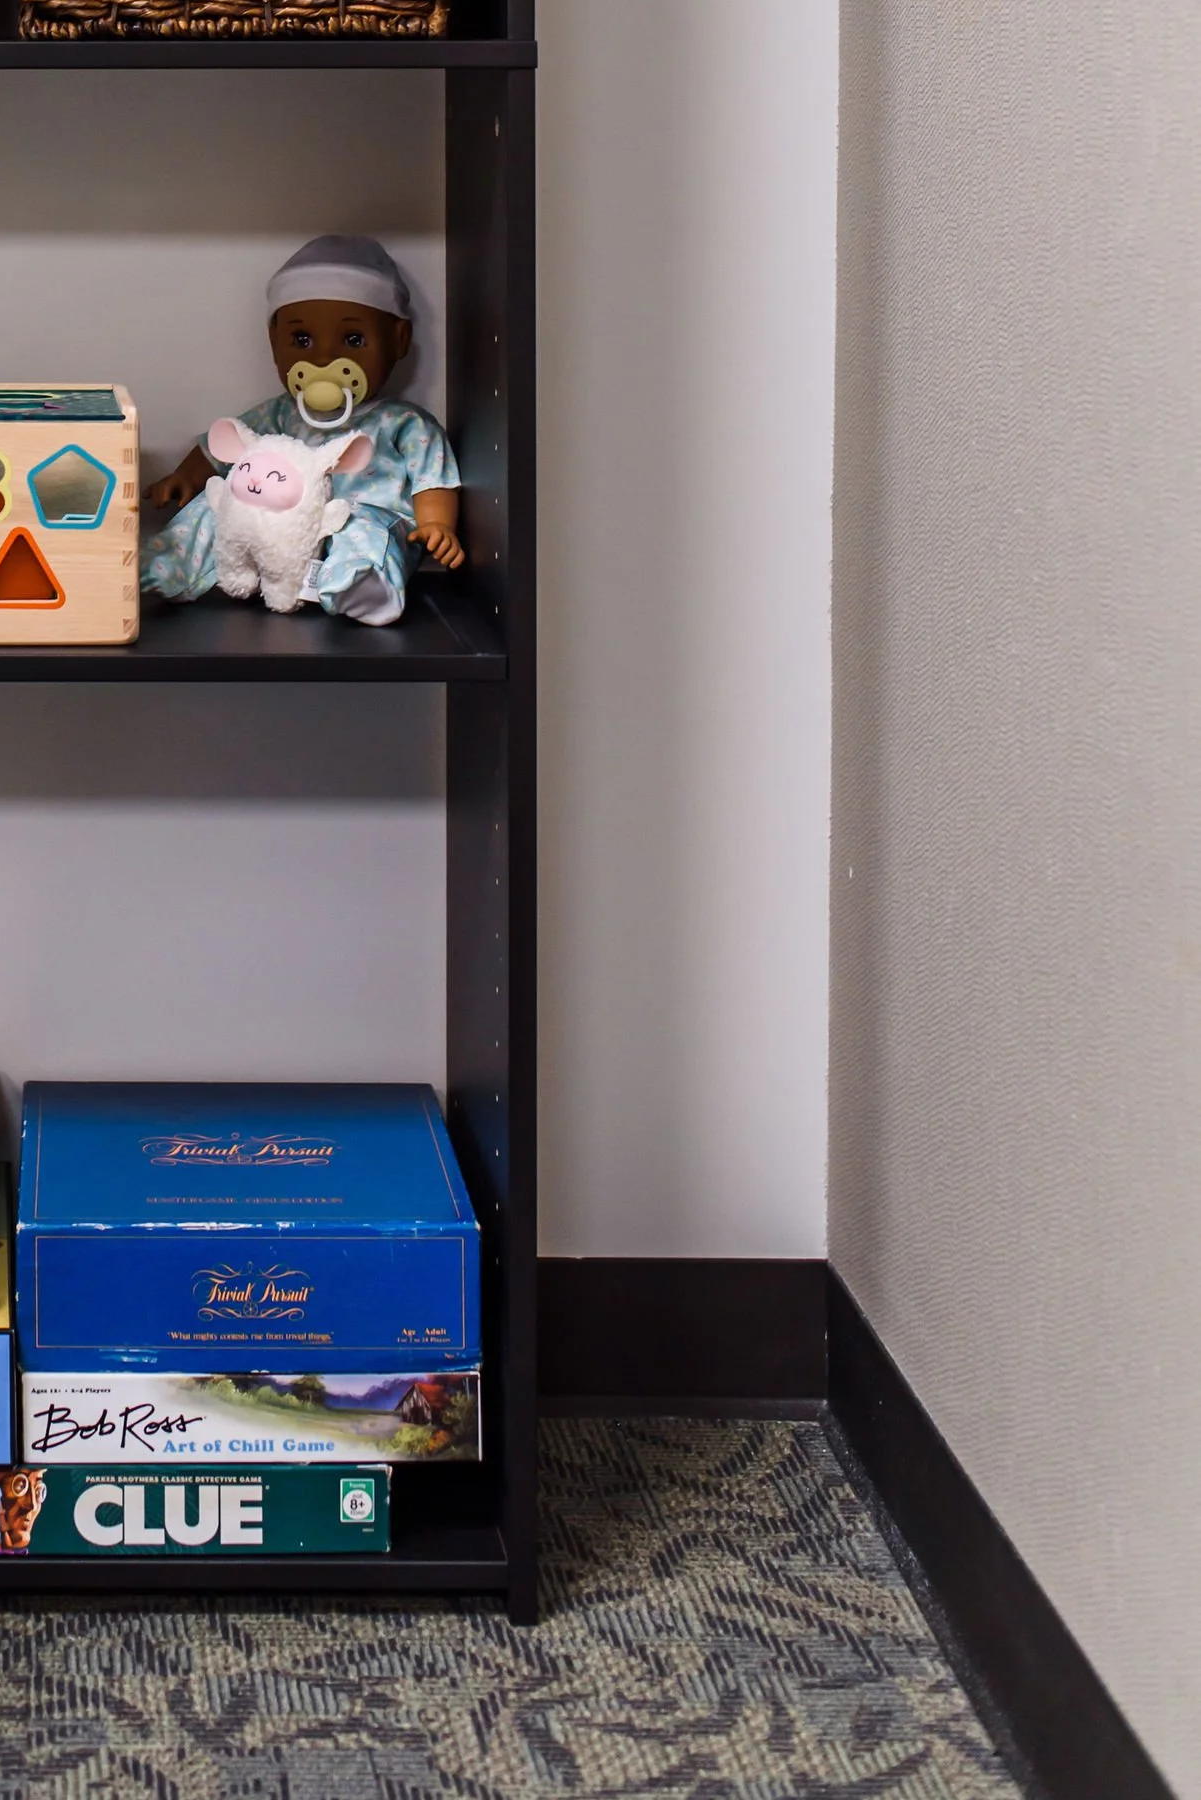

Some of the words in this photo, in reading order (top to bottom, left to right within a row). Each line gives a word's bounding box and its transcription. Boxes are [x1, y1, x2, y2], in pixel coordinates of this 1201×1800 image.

[167, 1141, 245, 1157] Trivial
[255, 1144, 335, 1157] Pursuit
[206, 1277, 255, 1304] Trivial
[259, 1280, 308, 1304] Pursuit
[31, 1404, 116, 1453] Bob
[119, 1403, 204, 1452] Ross
[162, 1439, 196, 1453] Art
[203, 1439, 223, 1453] of
[228, 1439, 275, 1452] Chill
[283, 1439, 336, 1452] Game
[73, 1484, 263, 1546] CLUE
[350, 1499, 365, 1510] 8+
